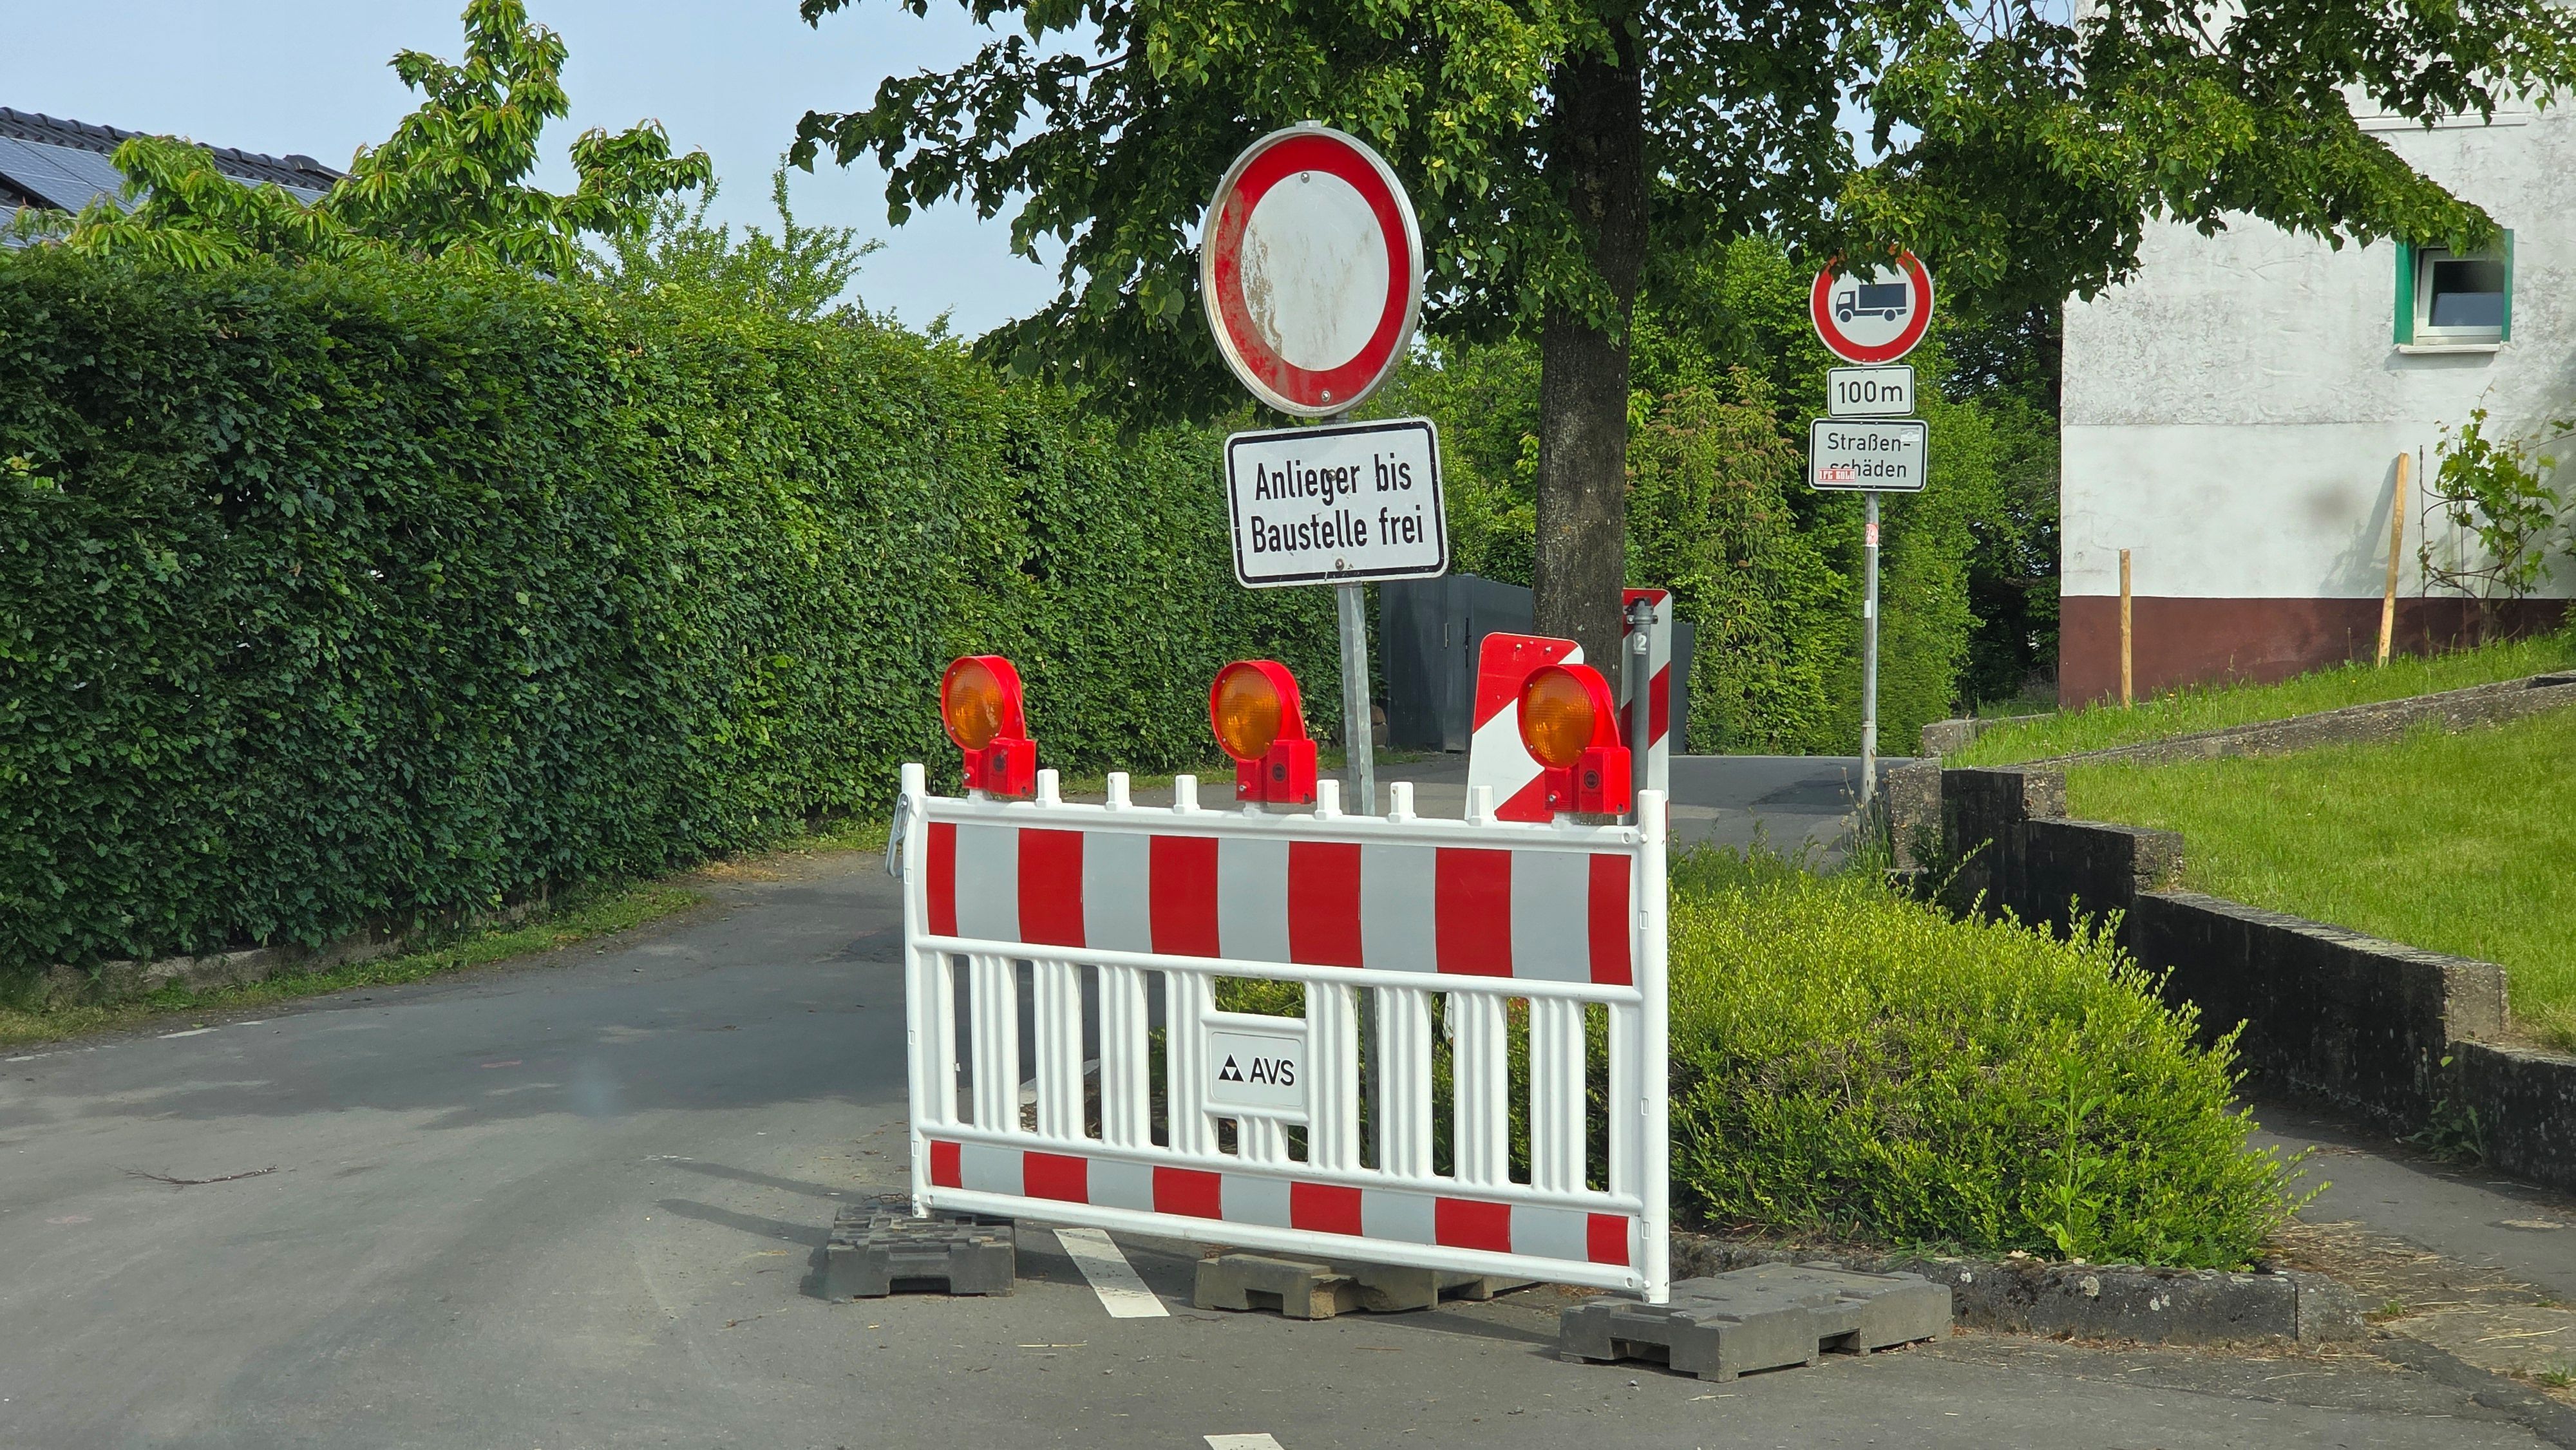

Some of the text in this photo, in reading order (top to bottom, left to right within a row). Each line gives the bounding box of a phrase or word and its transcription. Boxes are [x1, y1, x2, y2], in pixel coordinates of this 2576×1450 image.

[1827, 432, 1911, 452] Straßen-
[1255, 453, 1412, 506] Anlieger bis
[1251, 504, 1424, 553] Baustelle frei
[1249, 1057, 1295, 1087] AVS
